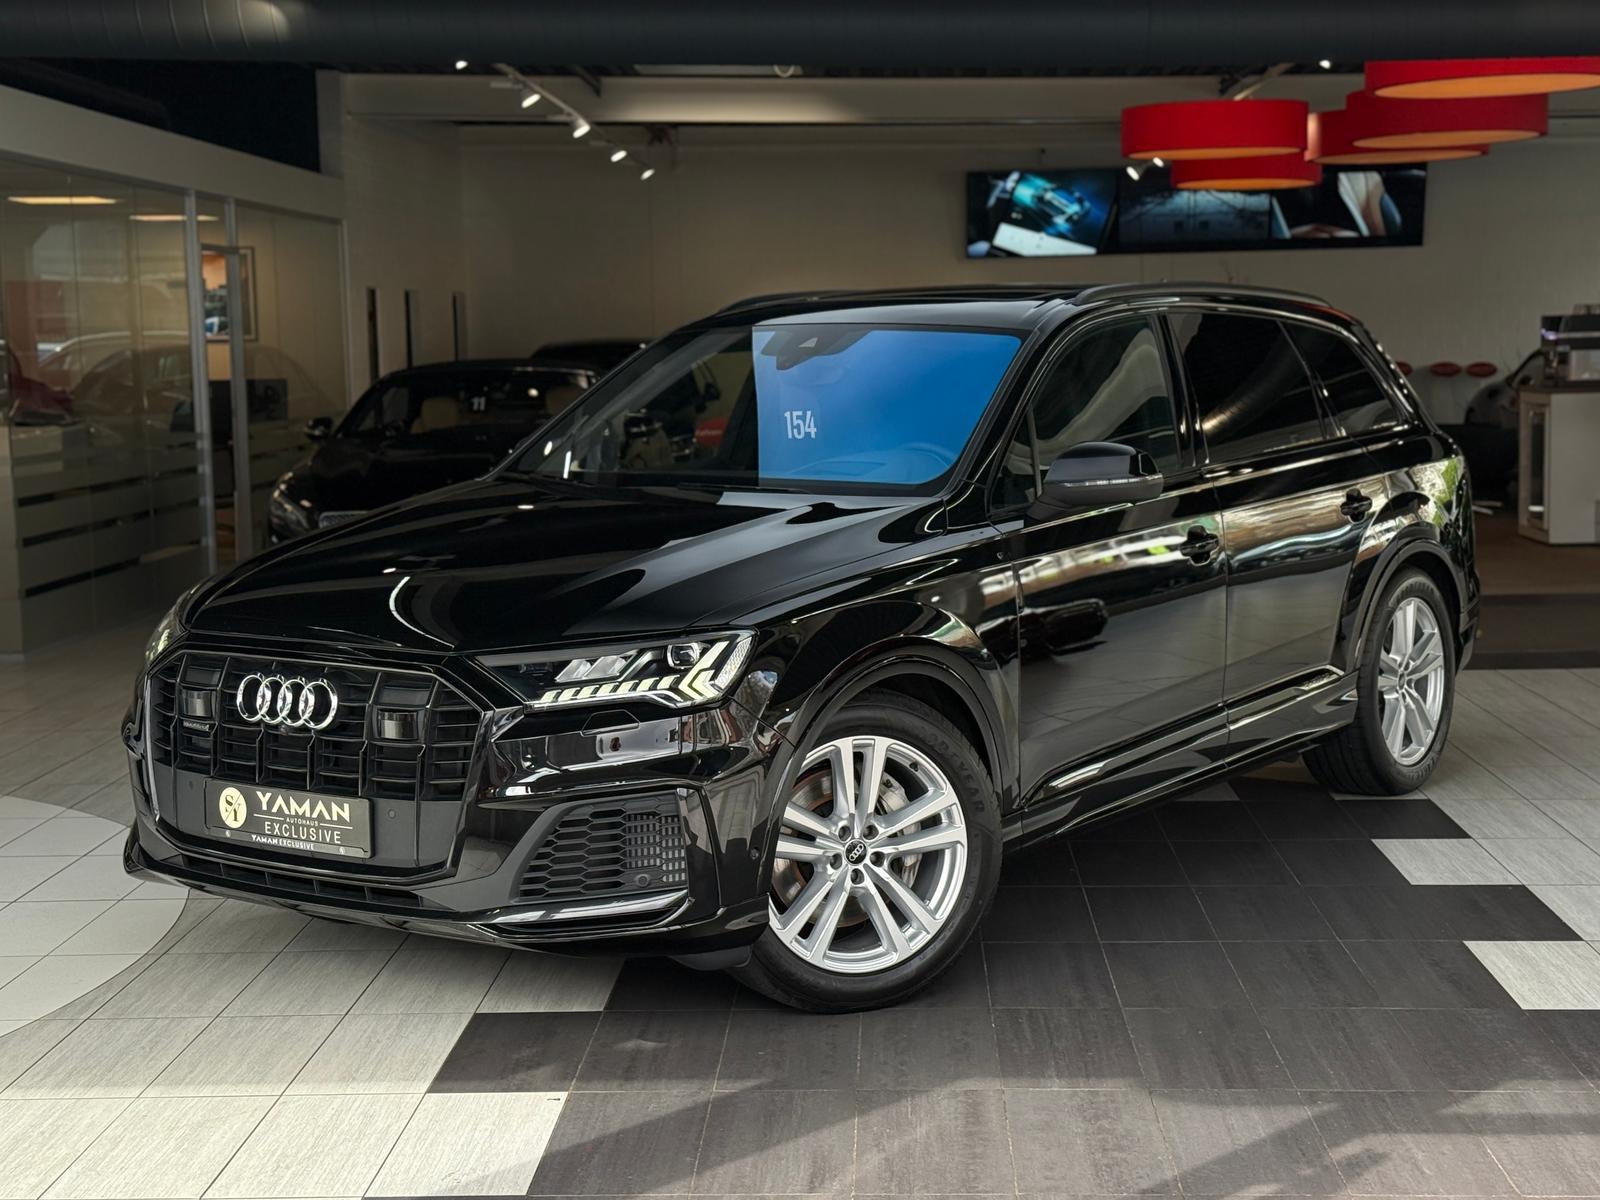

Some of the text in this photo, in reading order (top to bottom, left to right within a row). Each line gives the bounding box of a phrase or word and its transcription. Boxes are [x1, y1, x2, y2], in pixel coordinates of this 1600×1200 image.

[784, 410, 817, 439] 154
[256, 791, 350, 823] YAMAN
[265, 821, 341, 844] EXCLUSIVE
[286, 817, 318, 826] AUTOHAUS
[251, 834, 315, 850] YAMAN EXCLUSIVE
